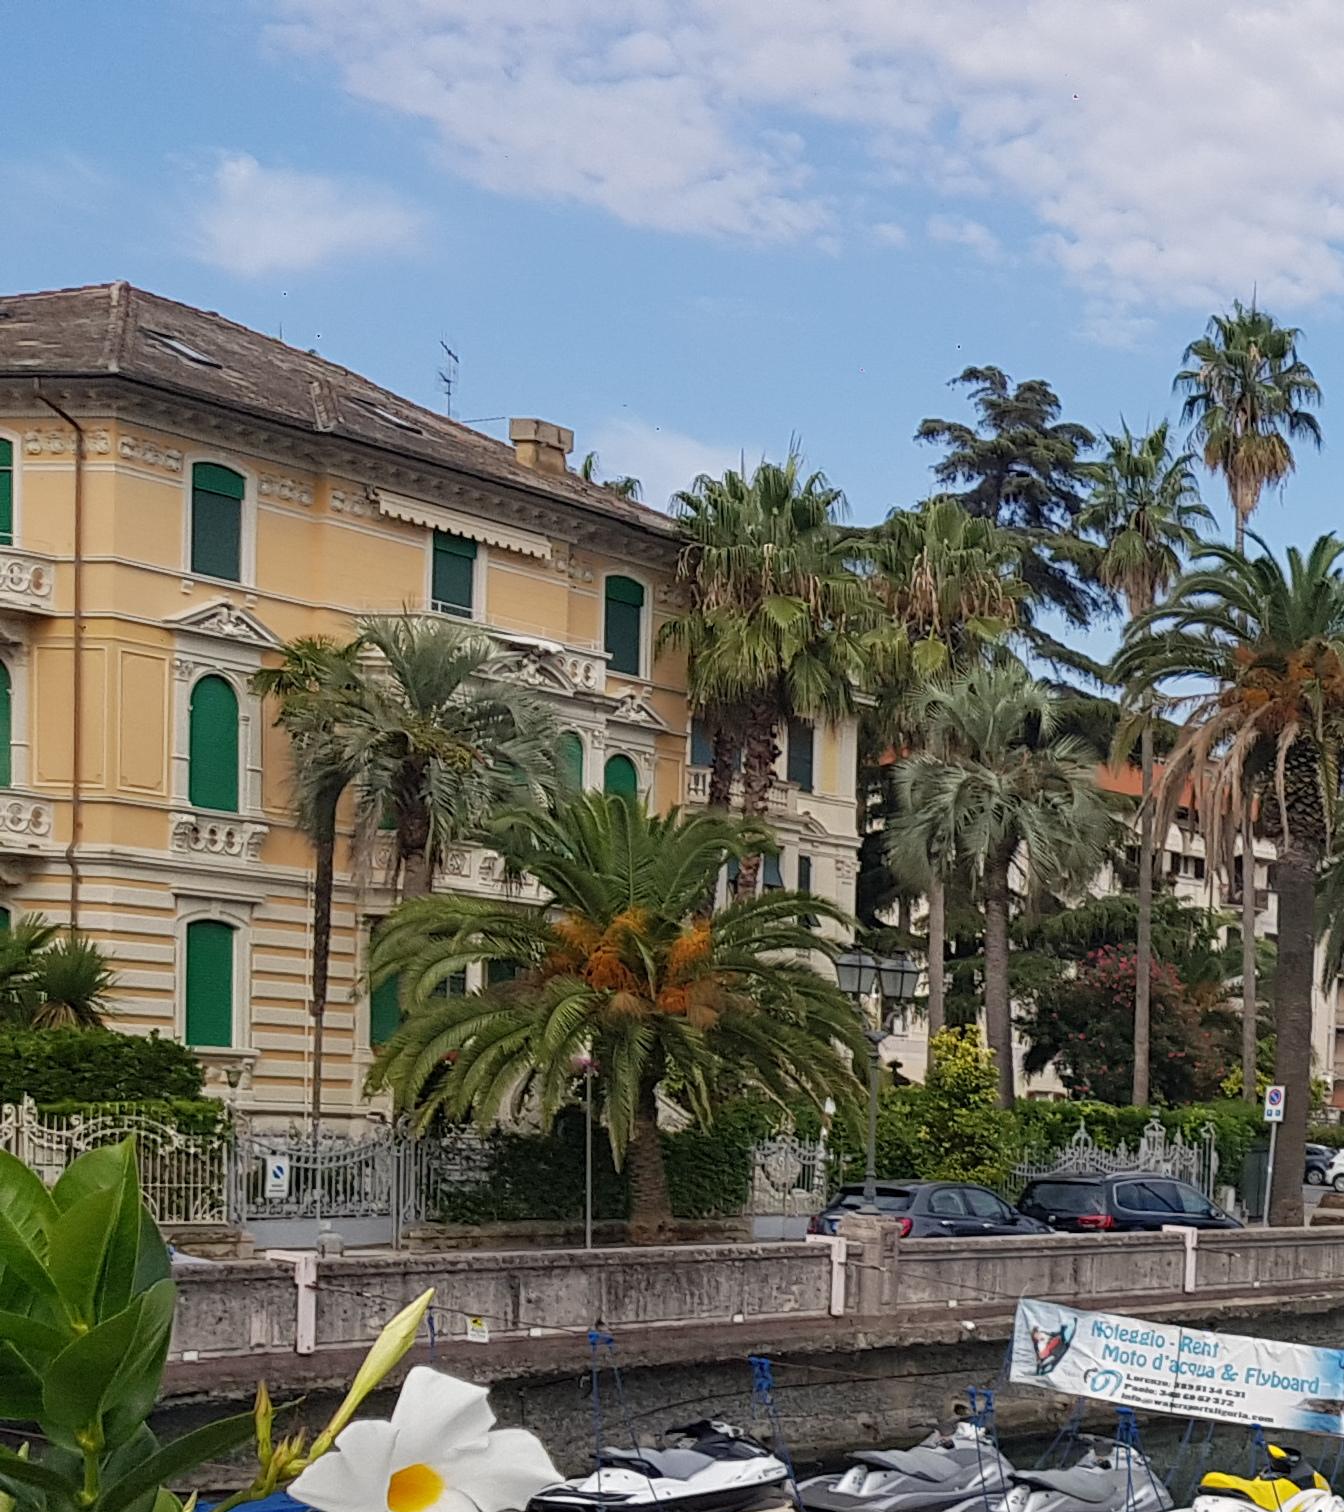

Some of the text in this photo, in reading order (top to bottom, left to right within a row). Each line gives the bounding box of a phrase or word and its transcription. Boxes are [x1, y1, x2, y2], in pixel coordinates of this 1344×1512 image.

[1091, 1319, 1165, 1349] Noleggio
[1180, 1336, 1219, 1358] Rent
[1102, 1344, 1319, 1394] Moto d'acqua & Flyboard
